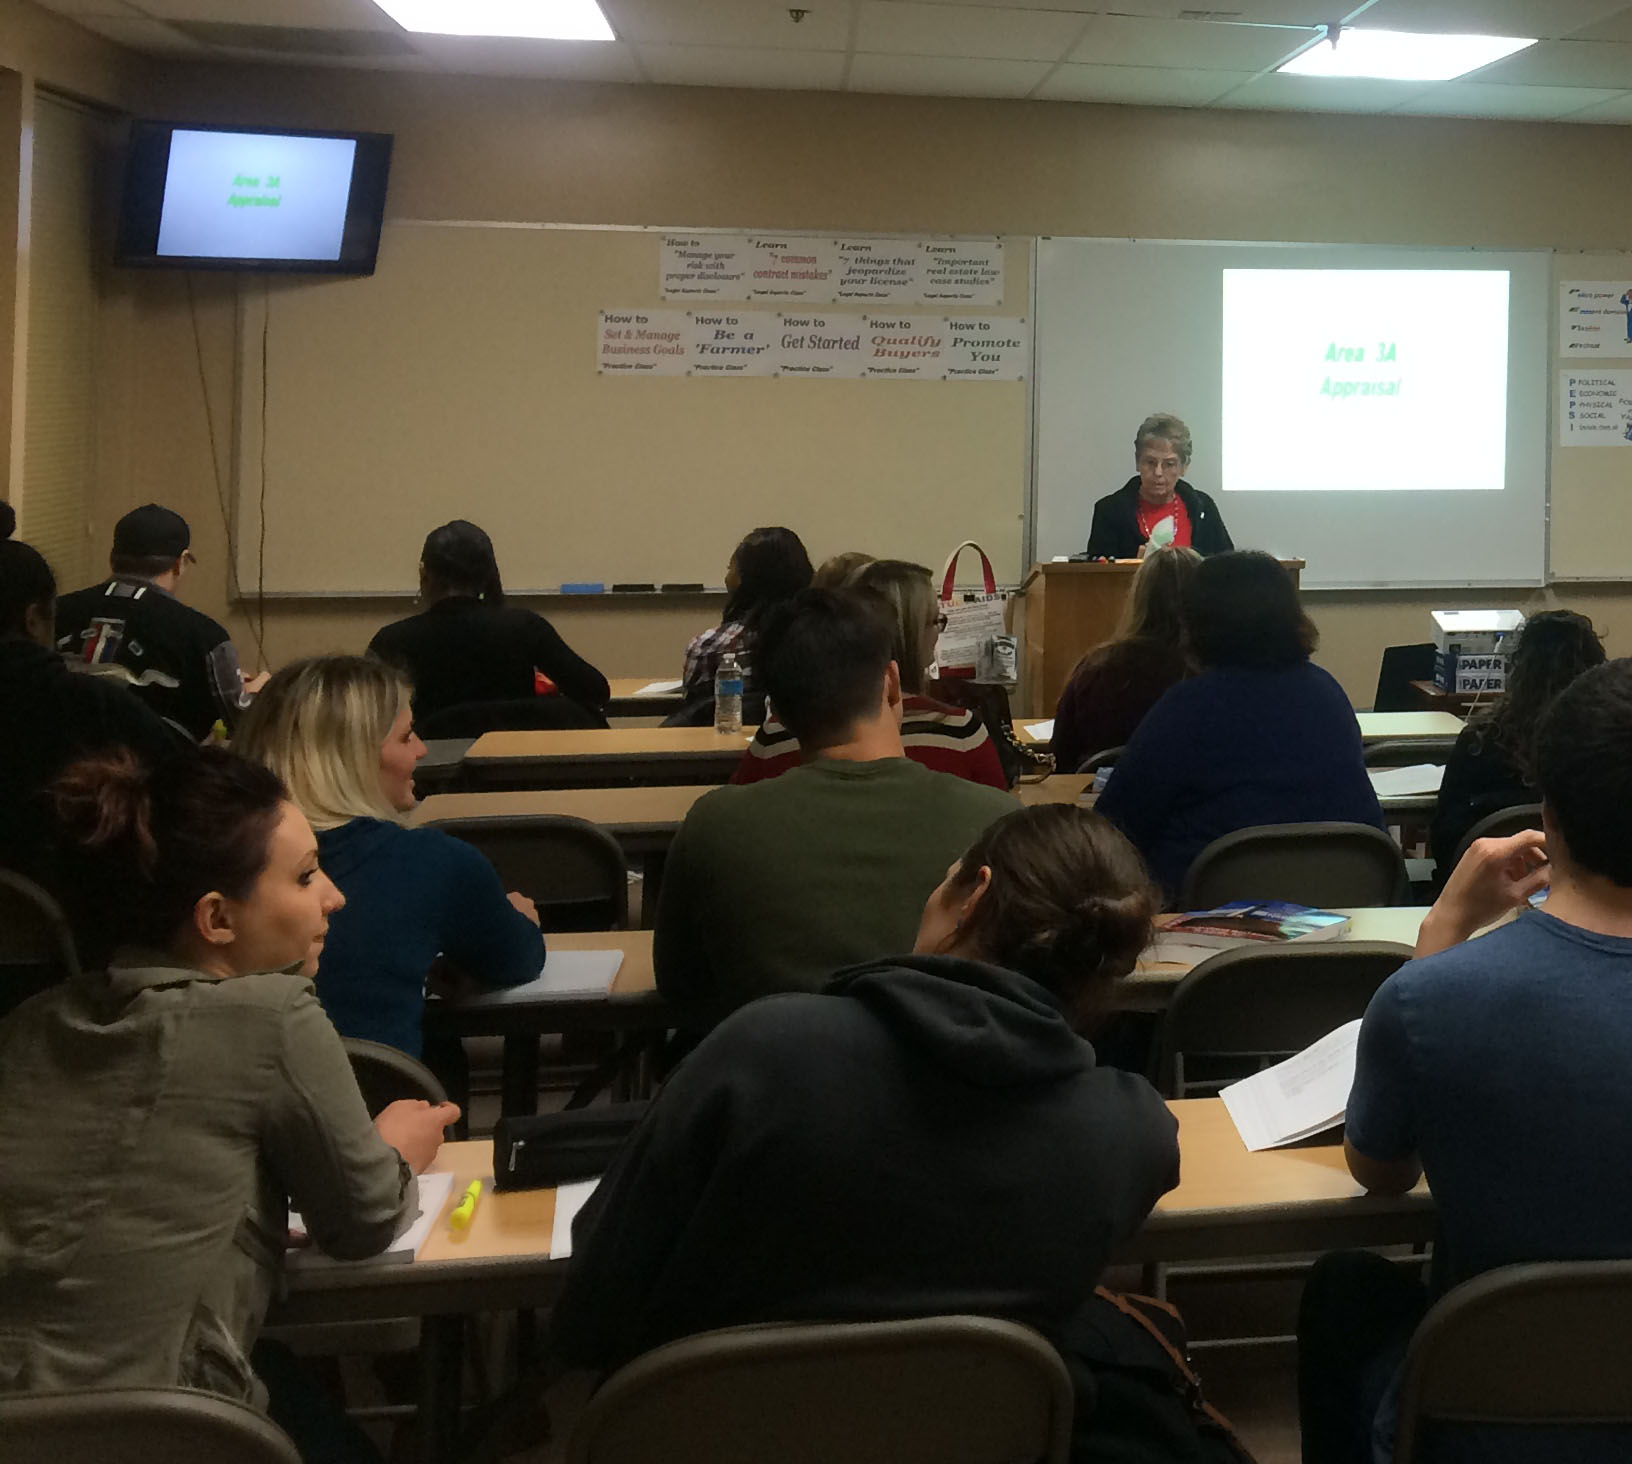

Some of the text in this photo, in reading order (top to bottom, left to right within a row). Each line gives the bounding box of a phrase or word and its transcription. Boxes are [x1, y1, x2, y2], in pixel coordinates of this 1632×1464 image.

[232, 173, 260, 188] Area
[226, 193, 281, 208] Appraisal
[667, 238, 689, 246] How
[755, 240, 788, 249] Learn
[840, 243, 872, 252] Learn
[926, 245, 956, 253] Learn
[714, 252, 736, 260] your
[781, 255, 817, 264] common
[854, 256, 890, 266] things
[892, 257, 915, 266] that
[705, 261, 725, 269] with
[753, 269, 789, 279] contract
[845, 266, 906, 276] jeopardize
[927, 267, 947, 275] real
[840, 278, 867, 286] your
[604, 315, 649, 324] How to
[695, 316, 739, 326] How to
[783, 318, 826, 328] How to
[870, 320, 912, 329] How to
[950, 322, 991, 331] How to
[603, 329, 681, 343] Set & Manage
[714, 330, 754, 340] Be a
[781, 334, 861, 351] Get Started
[871, 335, 942, 348] Qualify
[952, 337, 1021, 348] Promote
[602, 344, 685, 356] Business Goals
[696, 343, 770, 356] 'Farmer'
[873, 348, 941, 360] Buyers
[1324, 341, 1396, 362] Area 3A
[970, 351, 1001, 362] You
[1569, 378, 1576, 386] P
[1320, 376, 1402, 400] Appraisal
[1569, 389, 1576, 398] E
[1569, 400, 1576, 408] P
[1568, 410, 1576, 419] S
[1461, 659, 1502, 670] PAPER
